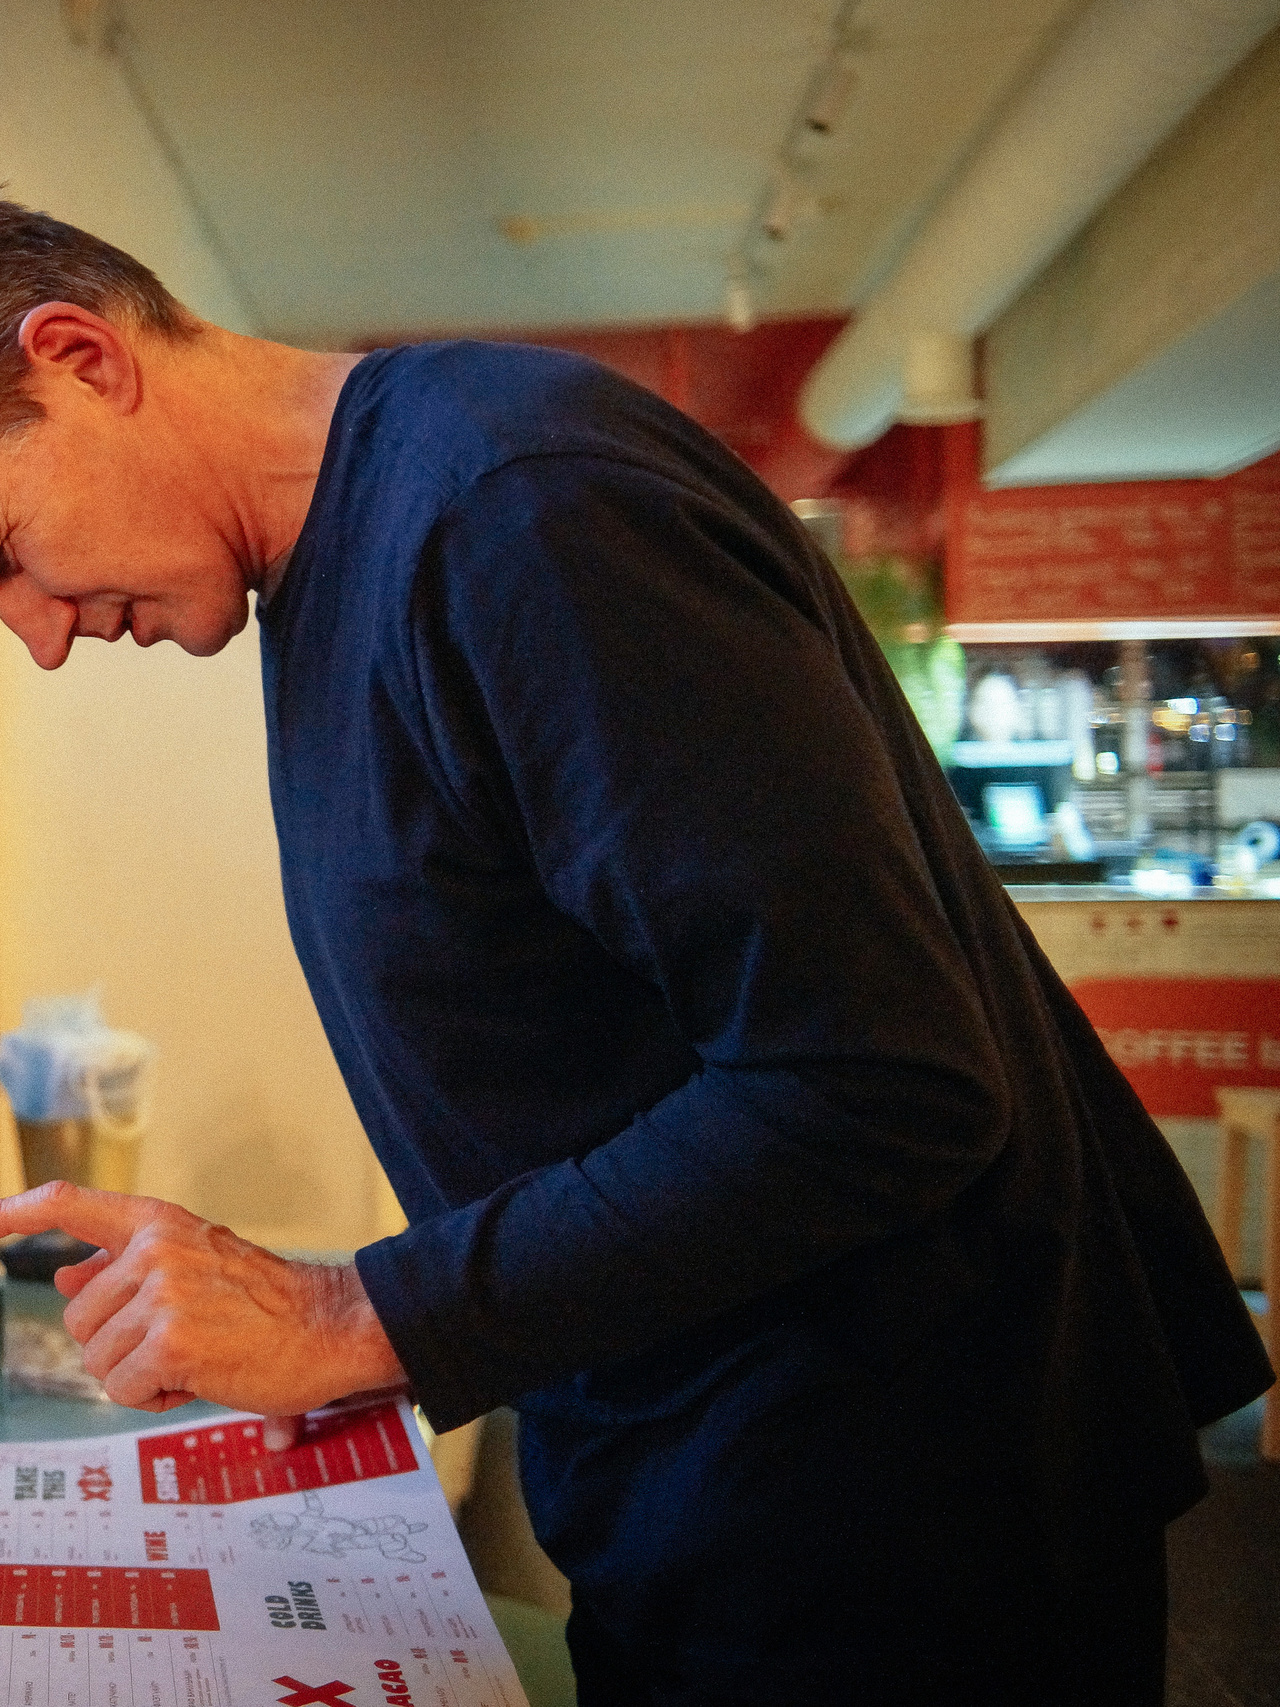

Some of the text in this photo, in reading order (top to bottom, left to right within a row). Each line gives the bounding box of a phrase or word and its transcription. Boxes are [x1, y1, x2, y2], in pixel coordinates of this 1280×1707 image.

[14, 1466, 37, 1500] TAKE
[144, 1530, 169, 1561] WINE
[264, 1594, 298, 1629] COLD
[287, 1580, 327, 1631] DRINKS
